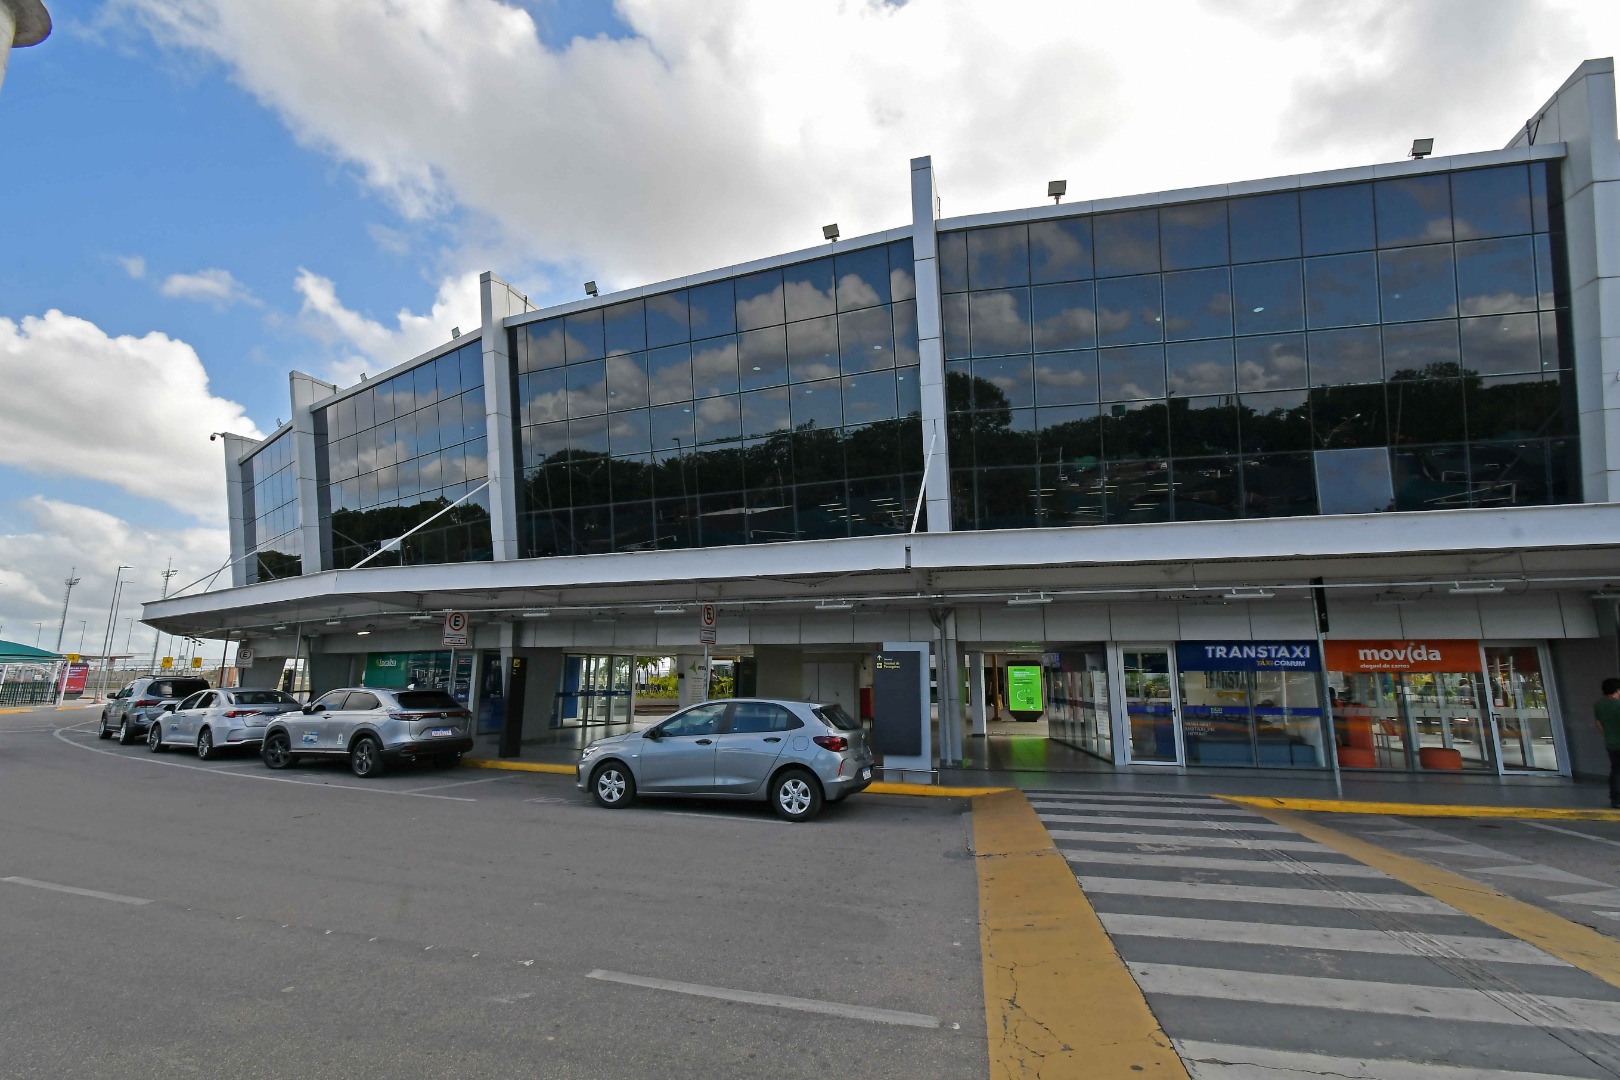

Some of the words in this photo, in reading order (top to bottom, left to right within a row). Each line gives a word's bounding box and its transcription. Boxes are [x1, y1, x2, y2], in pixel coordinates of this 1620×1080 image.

[454, 616, 460, 626] E
[1205, 645, 1310, 658] TRANSTAXI
[1358, 642, 1441, 664] movida
